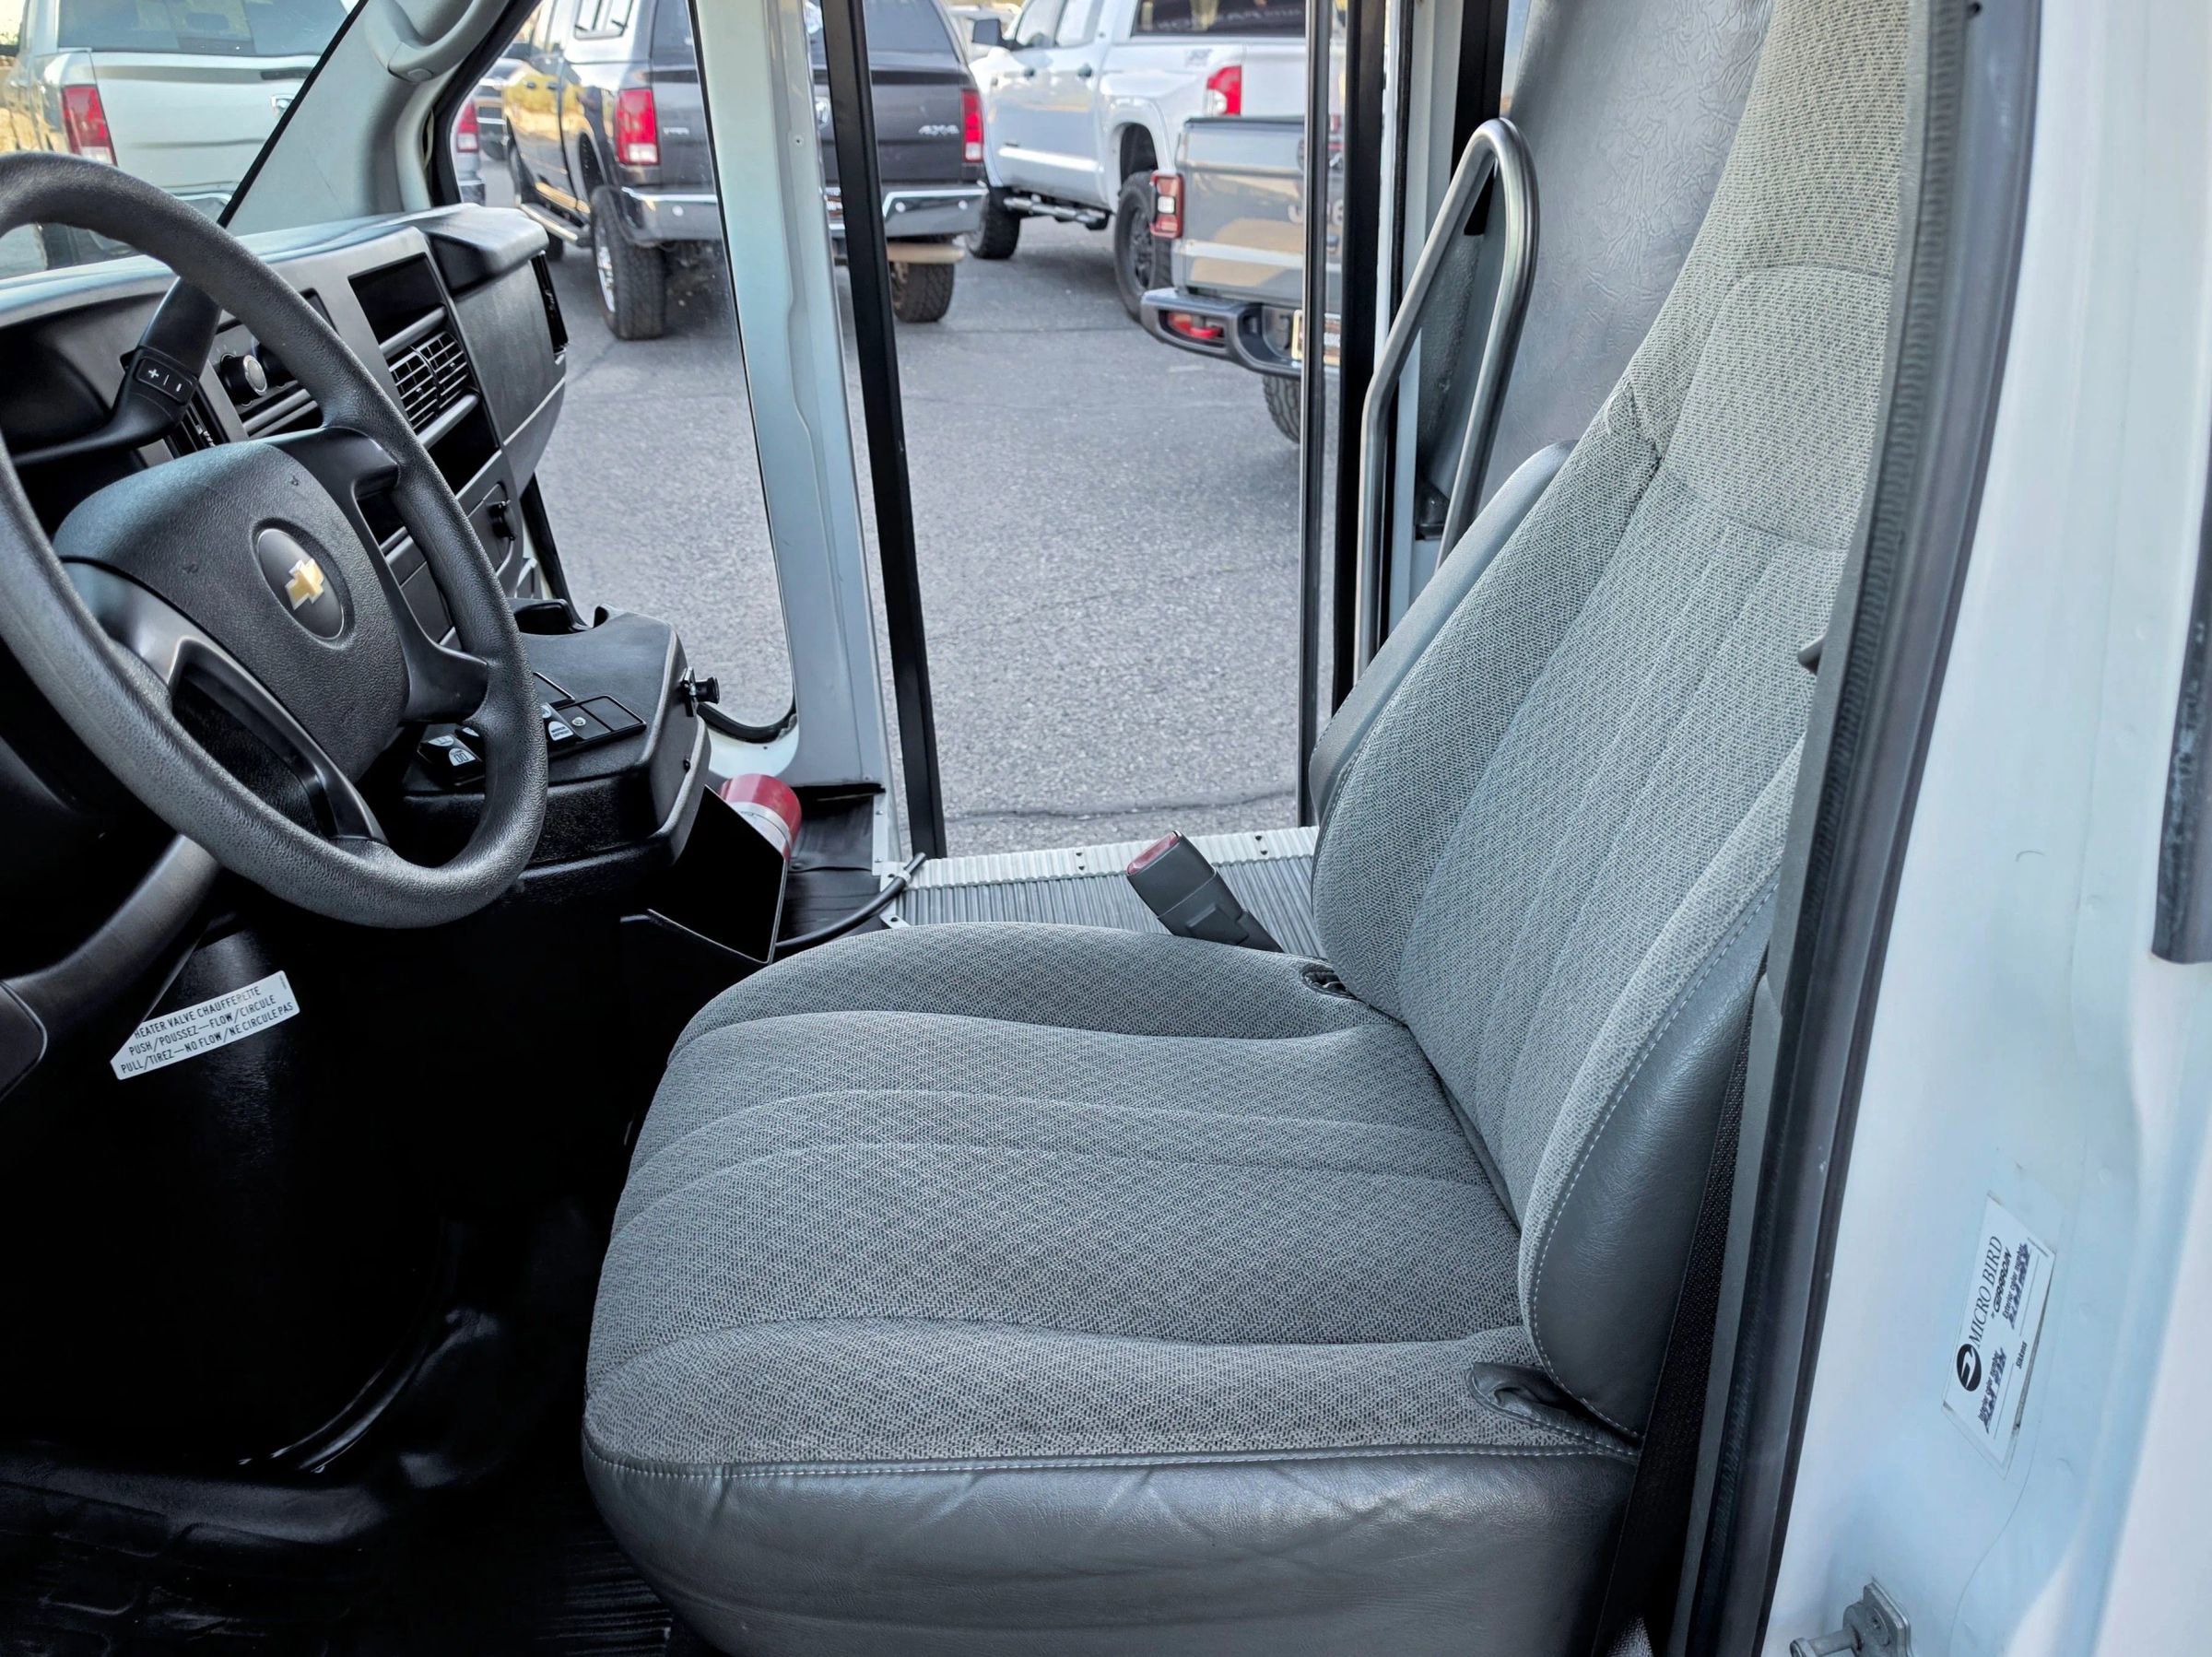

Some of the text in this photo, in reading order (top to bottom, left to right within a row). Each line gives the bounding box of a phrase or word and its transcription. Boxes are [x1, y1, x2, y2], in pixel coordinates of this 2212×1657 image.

[134, 985, 262, 1040] HEATER VALVE CHAUFFERETTE
[241, 1008, 278, 1031] CIRCULE
[277, 1002, 294, 1016] PAS
[1969, 1236, 2003, 1349] MICRO BIRD
[1993, 1246, 2011, 1313] GIRARDIN
[2002, 1291, 2013, 1319] Exterior
